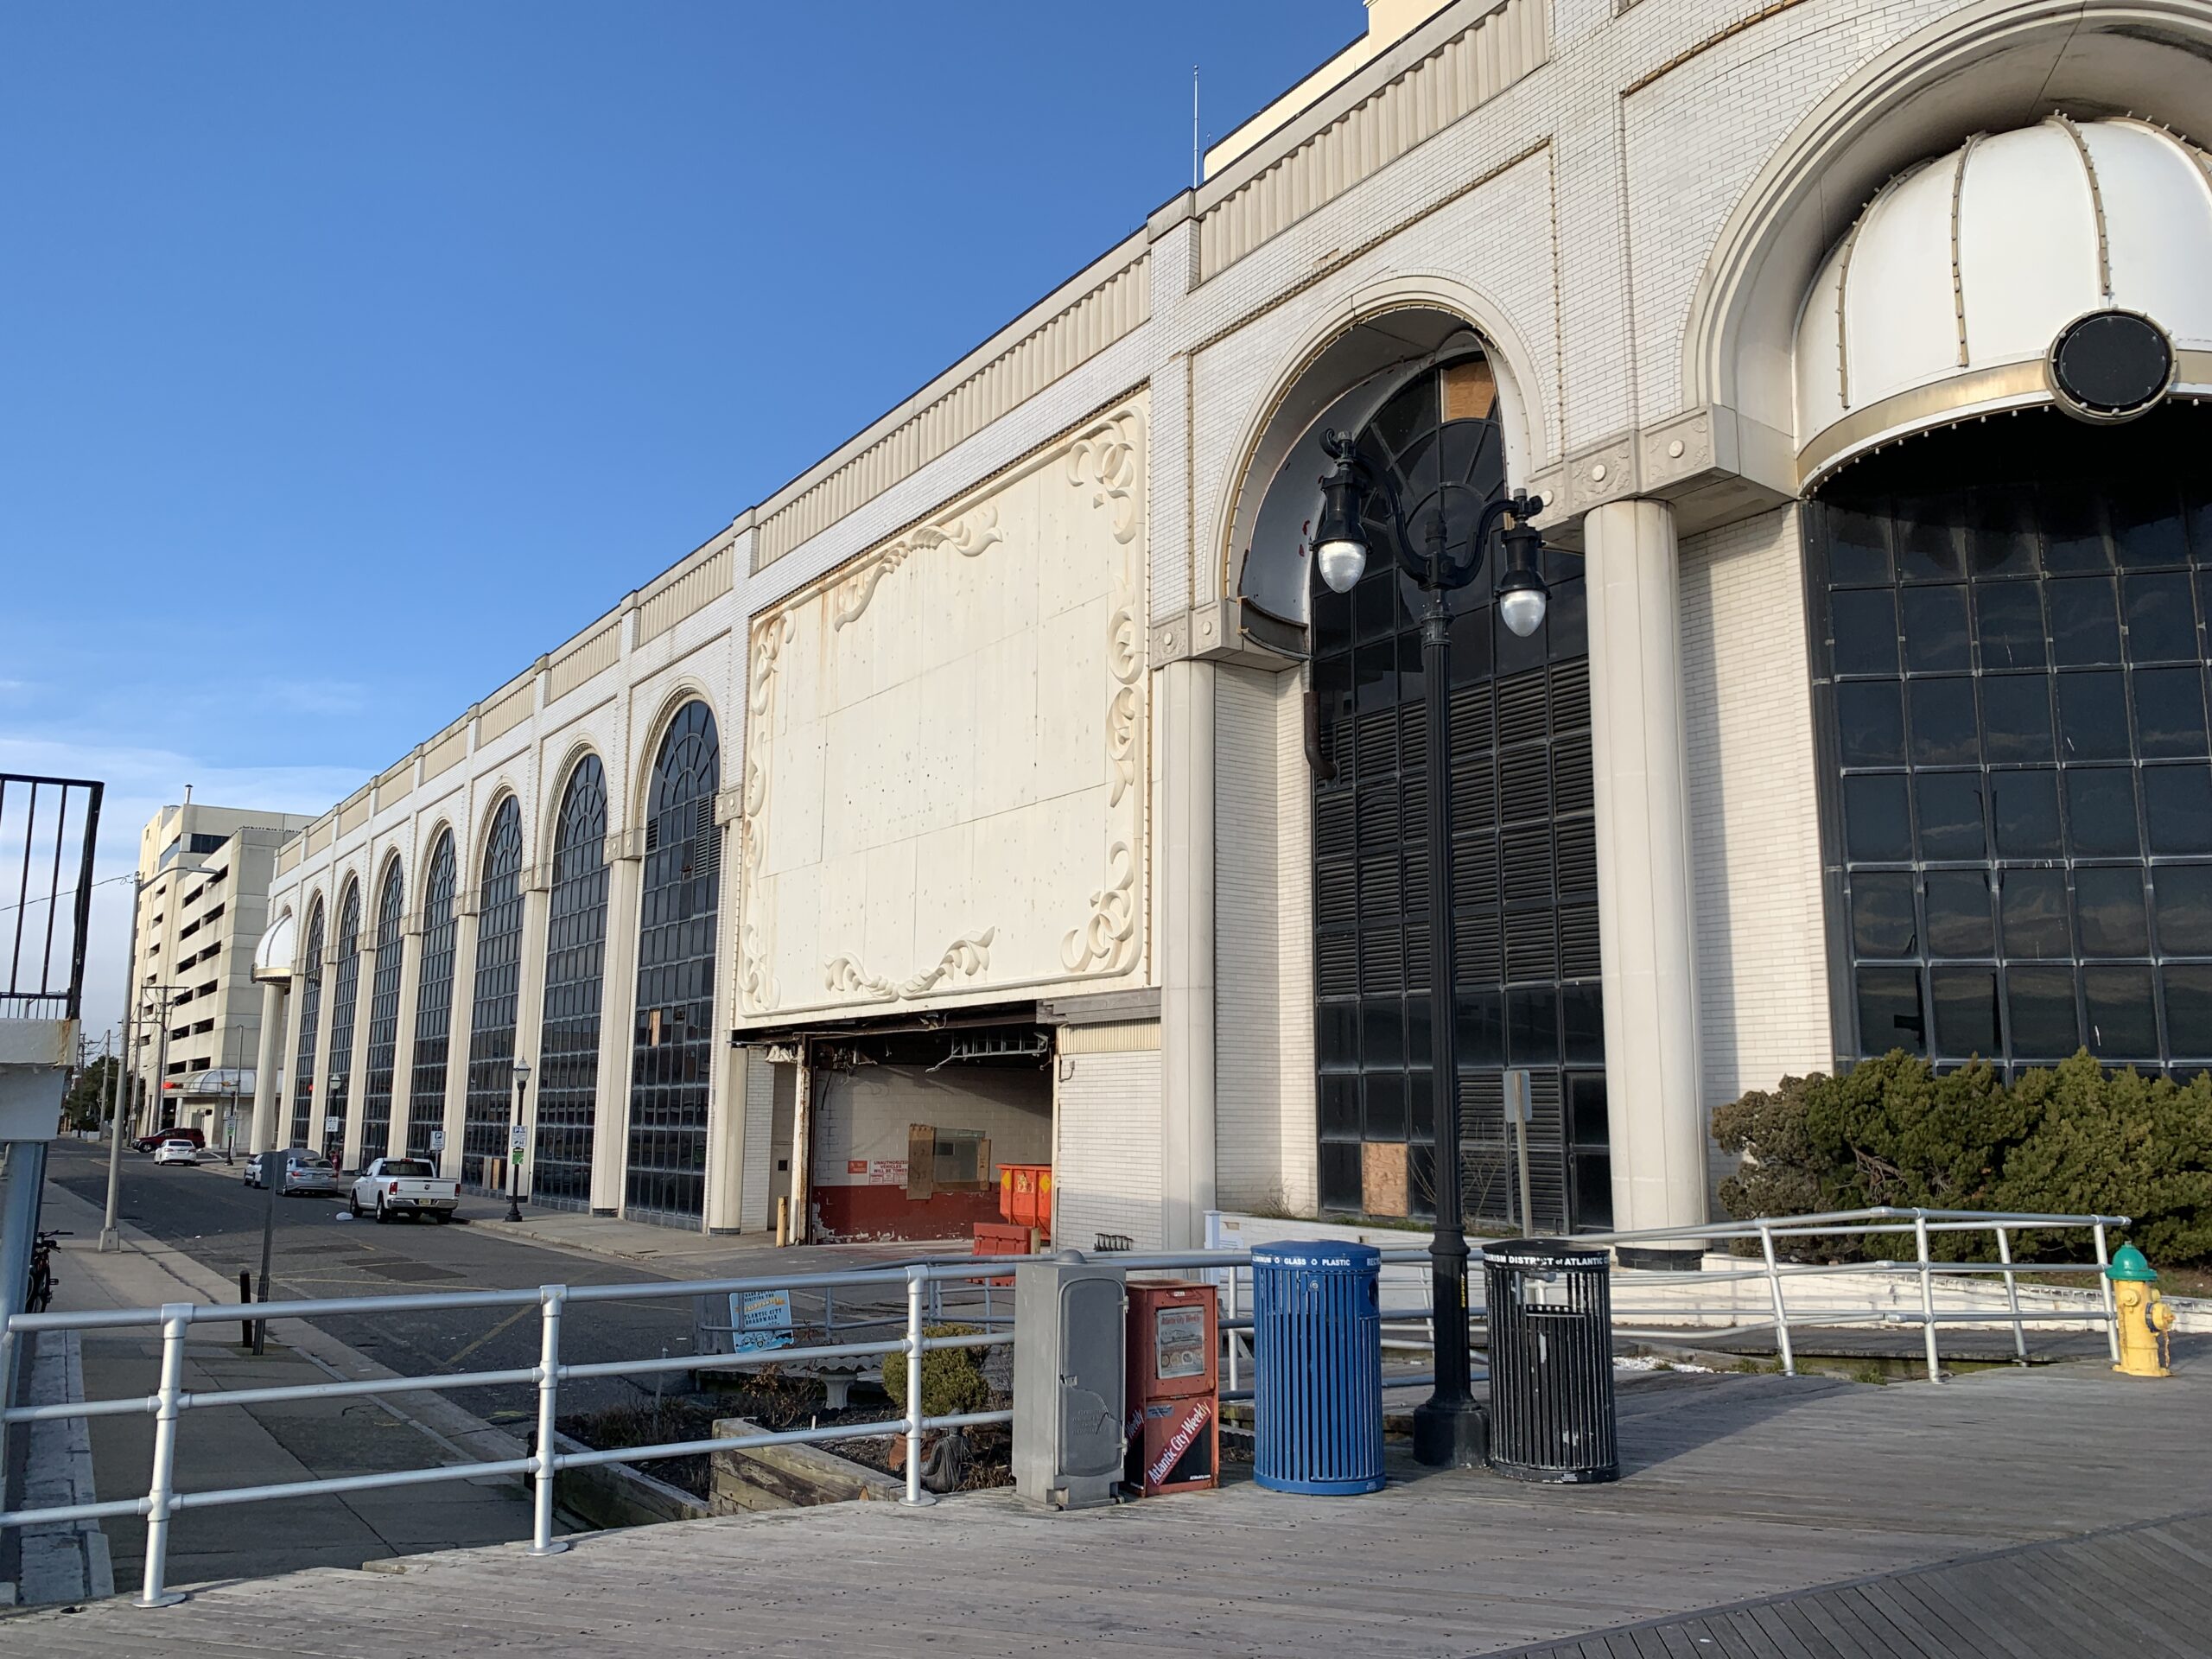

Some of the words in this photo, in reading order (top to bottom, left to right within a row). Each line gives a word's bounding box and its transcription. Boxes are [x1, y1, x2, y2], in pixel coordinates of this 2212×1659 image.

[1322, 1258, 1351, 1267] PLASTIC
[1564, 1257, 1603, 1266] ATLANTIC
[744, 1310, 768, 1320] TLANTIC
[746, 1314, 778, 1325] BOARDWALK
[1147, 1447, 1177, 1484] Atlantic
[1170, 1431, 1190, 1452] City
[1180, 1402, 1211, 1434] Weekly
